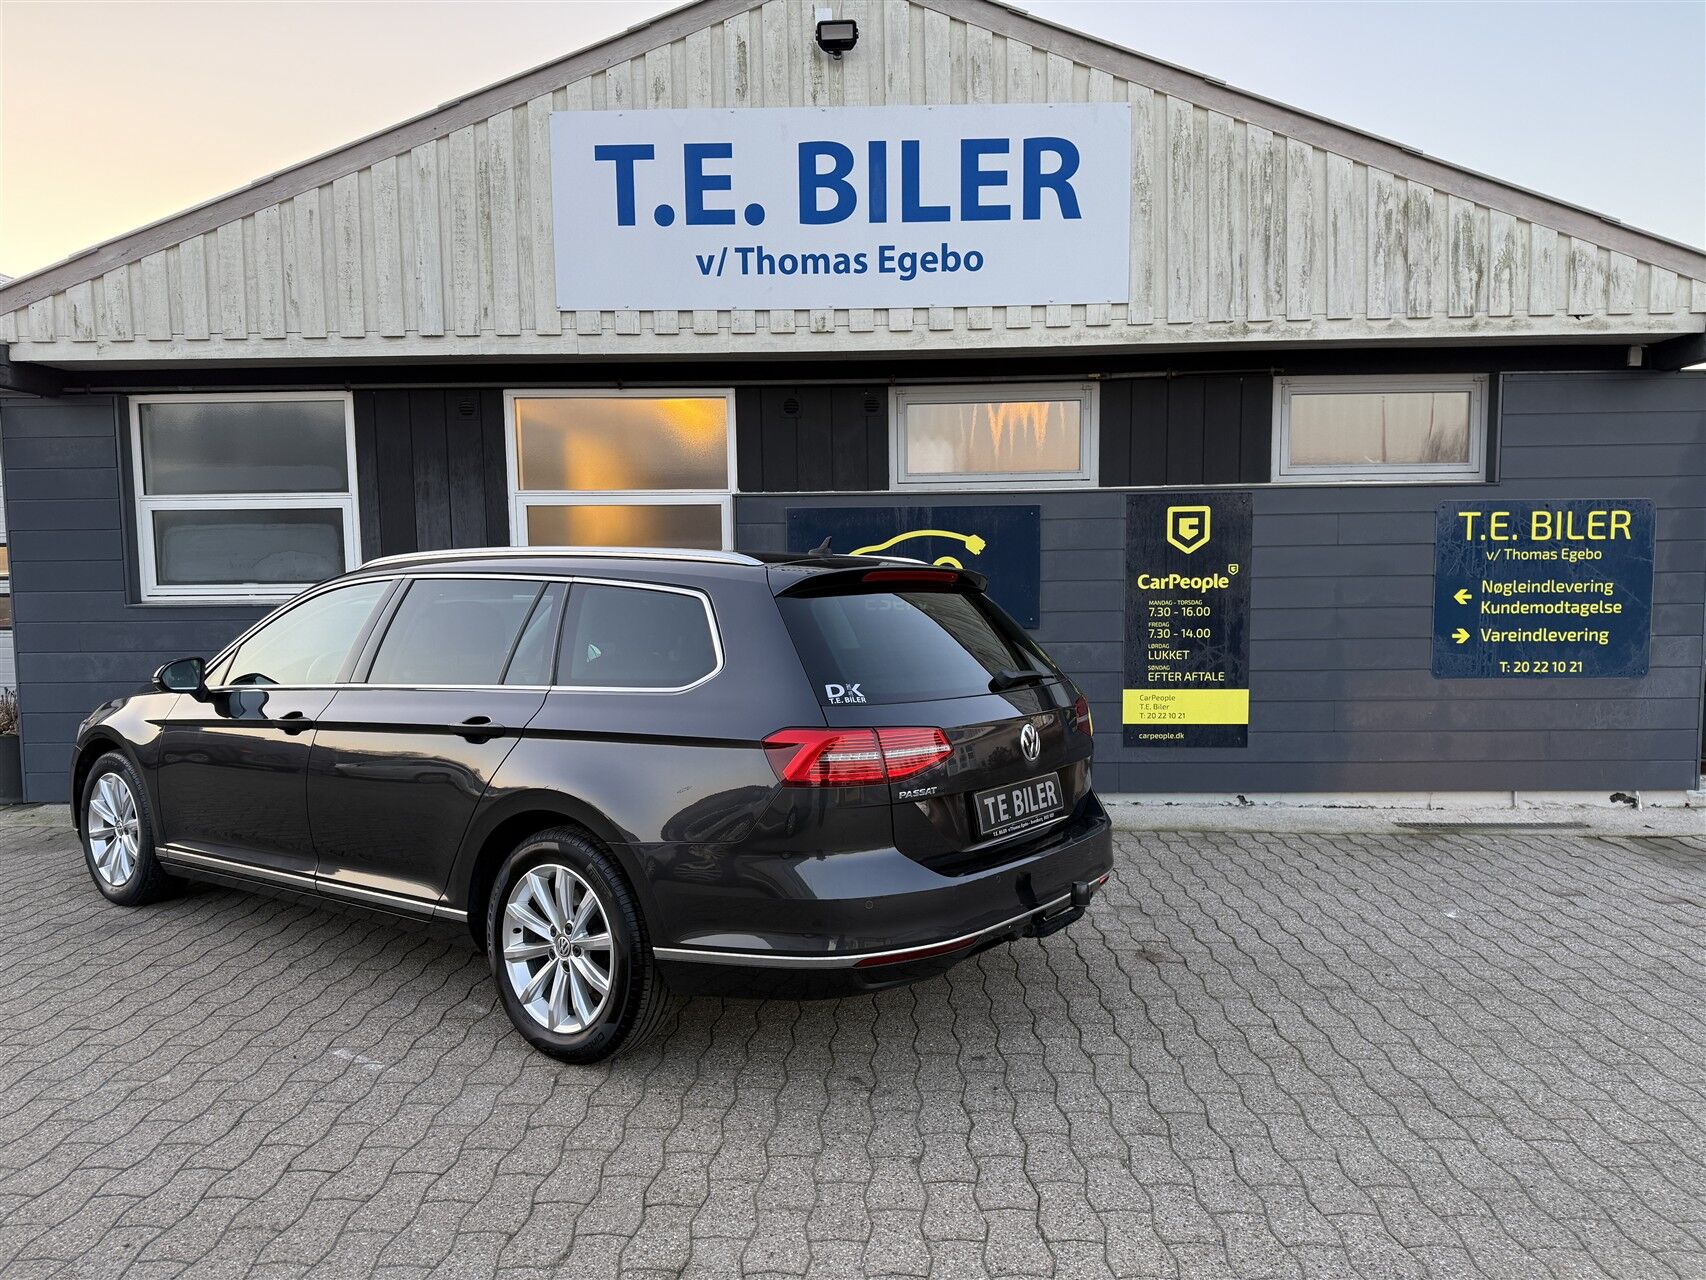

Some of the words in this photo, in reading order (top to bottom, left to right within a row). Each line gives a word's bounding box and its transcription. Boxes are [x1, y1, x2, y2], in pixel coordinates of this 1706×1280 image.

[594, 142, 766, 227] T.E.
[799, 136, 1082, 225] BILER
[696, 247, 727, 277] v/
[735, 246, 868, 275] Thomas
[879, 243, 984, 282] Egebo
[1458, 511, 1518, 541] T.E.
[1531, 510, 1632, 540] BILER
[1486, 549, 1501, 561] v/
[1504, 548, 1557, 560] Thomas
[1561, 548, 1602, 563] Egebo
[1137, 573, 1229, 593] CarPeople
[1481, 579, 1614, 596] Nøgleindlevering
[1148, 607, 1171, 617] 7.30
[1181, 606, 1211, 616] 16.00
[1481, 601, 1622, 617] Kundemodtagelse
[1148, 628, 1171, 638] 7.30
[1180, 628, 1211, 638] 14.00
[1481, 628, 1610, 645] Vareindlevering
[1148, 650, 1190, 660] LUKKET
[1499, 662, 1511, 673] T:
[1513, 661, 1530, 673] 20
[1533, 661, 1549, 672] 22
[1552, 661, 1567, 672] 10
[1569, 661, 1583, 672] 21
[1148, 672, 1182, 681] EFTER
[1184, 671, 1225, 681] AFTALE
[1139, 694, 1176, 702] CarPeople
[1138, 732, 1185, 740] carpeople.dk
[899, 786, 938, 799] PASSAT
[1012, 780, 1058, 817] BILER
